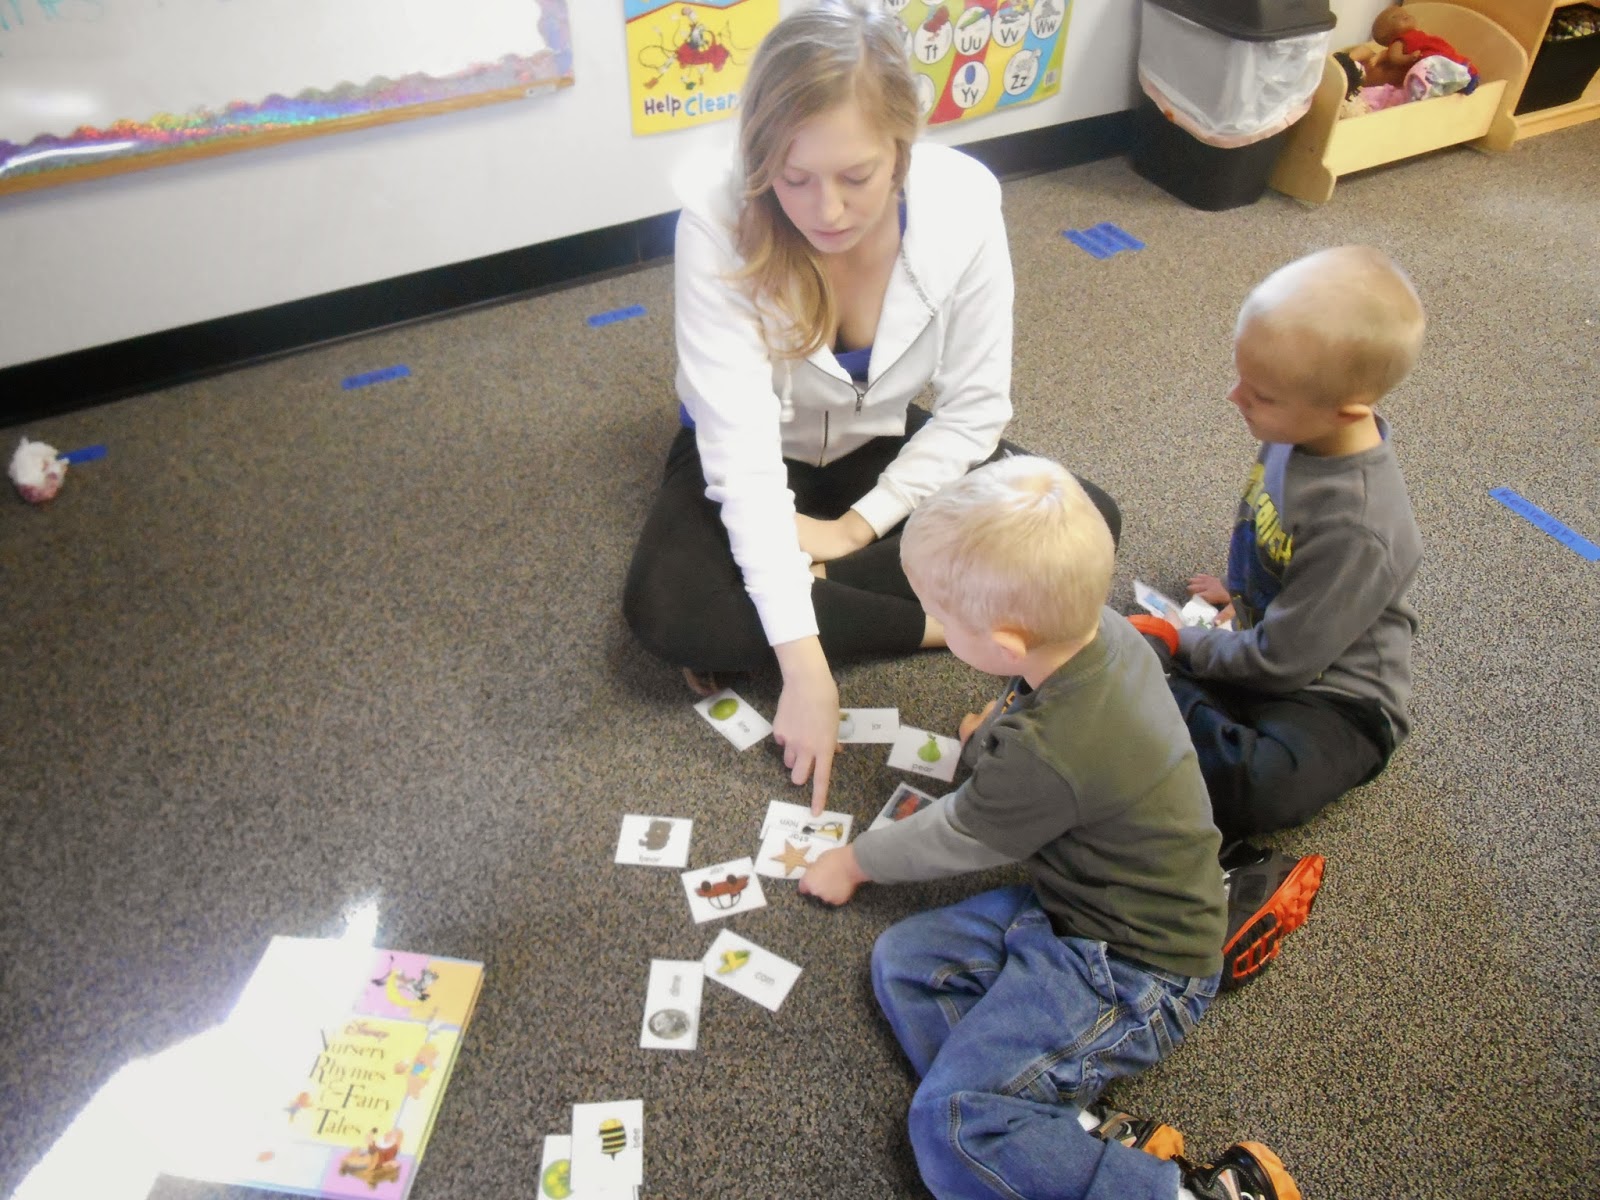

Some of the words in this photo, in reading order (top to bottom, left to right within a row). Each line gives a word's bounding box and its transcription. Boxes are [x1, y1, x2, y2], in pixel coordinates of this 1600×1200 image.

[961, 36, 982, 53] Uu
[1000, 27, 1019, 43] Vv
[924, 44, 939, 61] Tt
[1010, 74, 1028, 90] Zz
[644, 93, 682, 117] Help
[961, 86, 980, 106] Yy
[308, 1053, 387, 1085] Rhymes
[341, 1083, 391, 1112] Fairy
[316, 1107, 362, 1136] Tales
